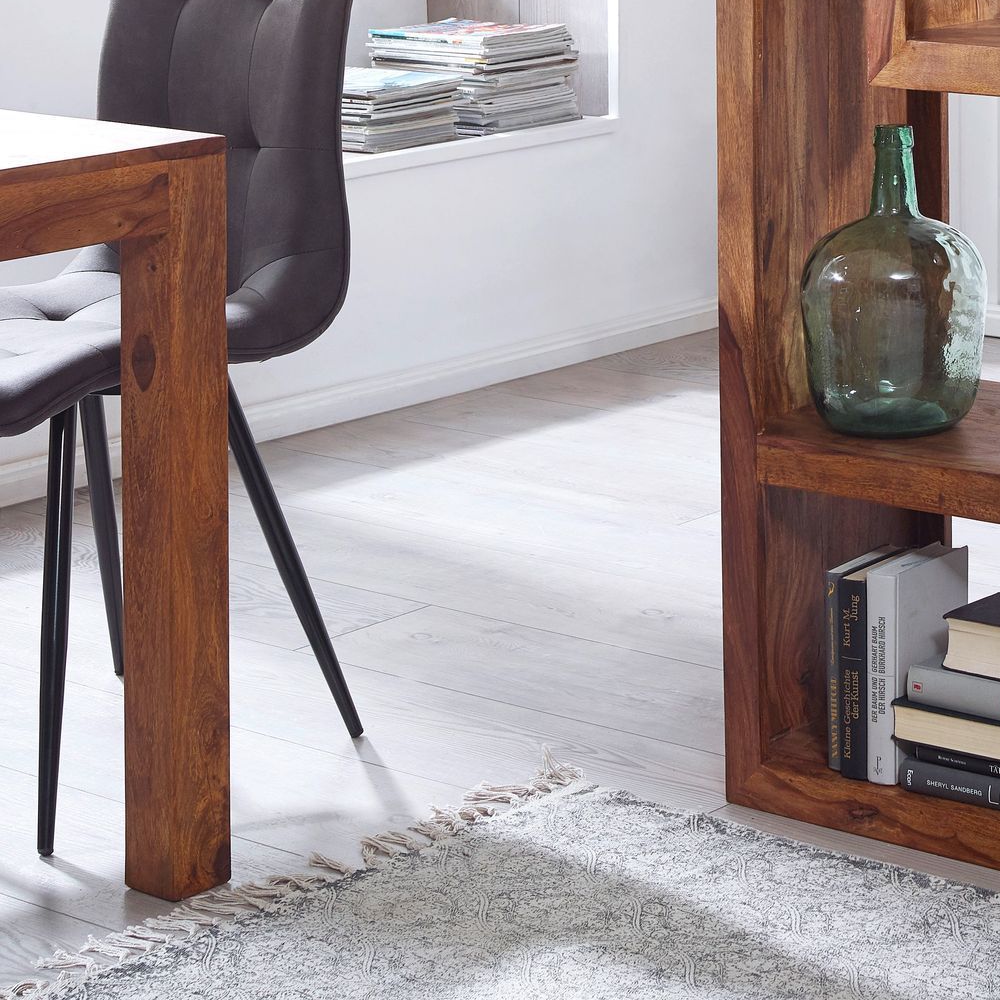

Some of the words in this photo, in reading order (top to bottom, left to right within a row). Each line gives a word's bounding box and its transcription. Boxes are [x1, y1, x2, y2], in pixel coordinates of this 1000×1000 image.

[849, 594, 860, 621] Jung
[842, 623, 851, 647] Kurt
[878, 616, 886, 639] HIRSCH
[878, 640, 886, 674] BURKHARD
[843, 669, 851, 725] Geschichte
[851, 670, 859, 702] Kunst
[878, 677, 886, 701] HIRSCH
[851, 703, 859, 720] der
[878, 702, 886, 715] DER
[843, 726, 851, 759] Kleine
[906, 769, 914, 786] Econ
[926, 780, 949, 790] SHERYL
[950, 784, 983, 797] SANDBERG
